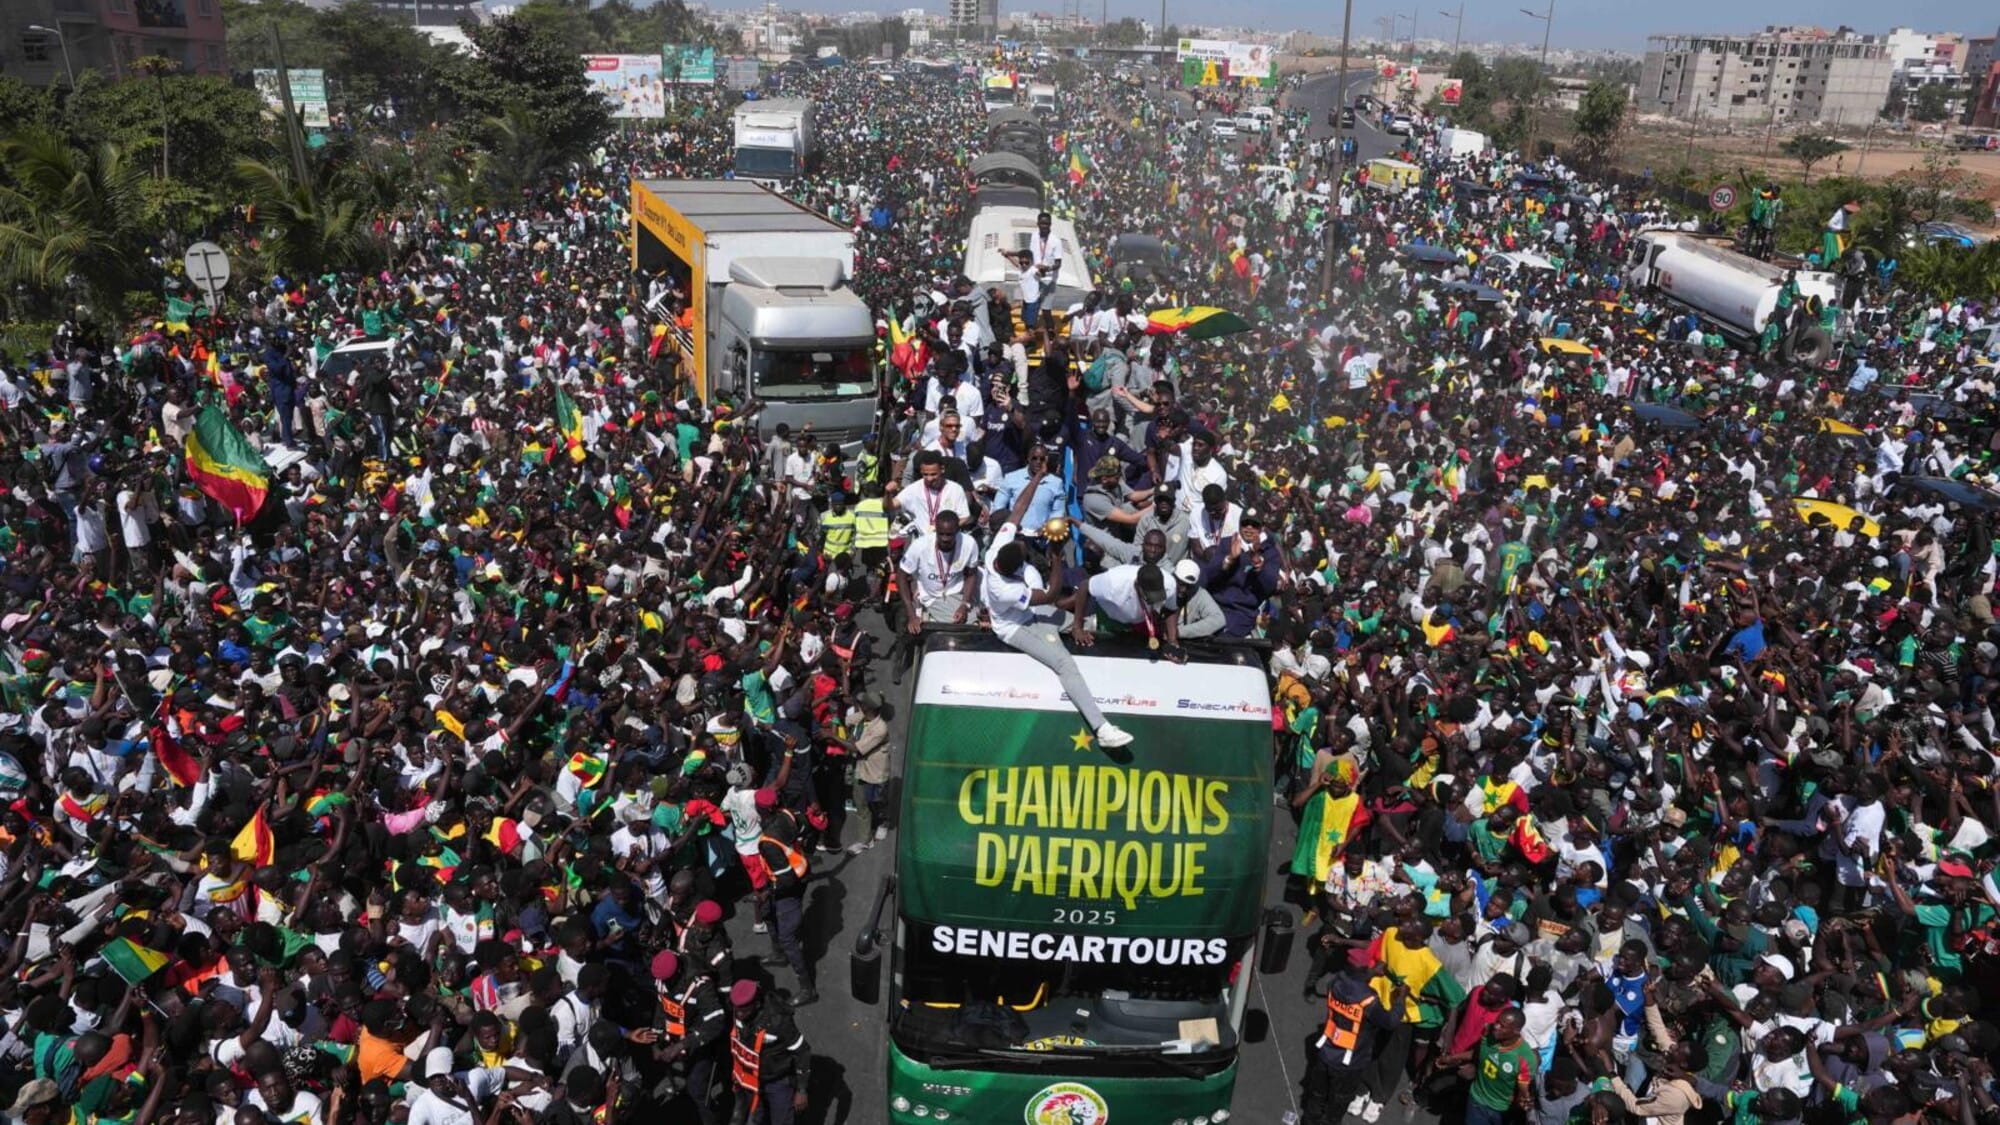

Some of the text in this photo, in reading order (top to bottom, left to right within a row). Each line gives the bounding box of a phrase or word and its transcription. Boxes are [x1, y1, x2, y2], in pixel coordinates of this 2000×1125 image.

[1715, 191, 1731, 204] 90
[958, 765, 1230, 836] CHAMPIONS
[975, 832, 1207, 910] D'AFRIQUE
[1053, 908, 1116, 925] 2025
[931, 925, 1228, 966] SENECARTOURS
